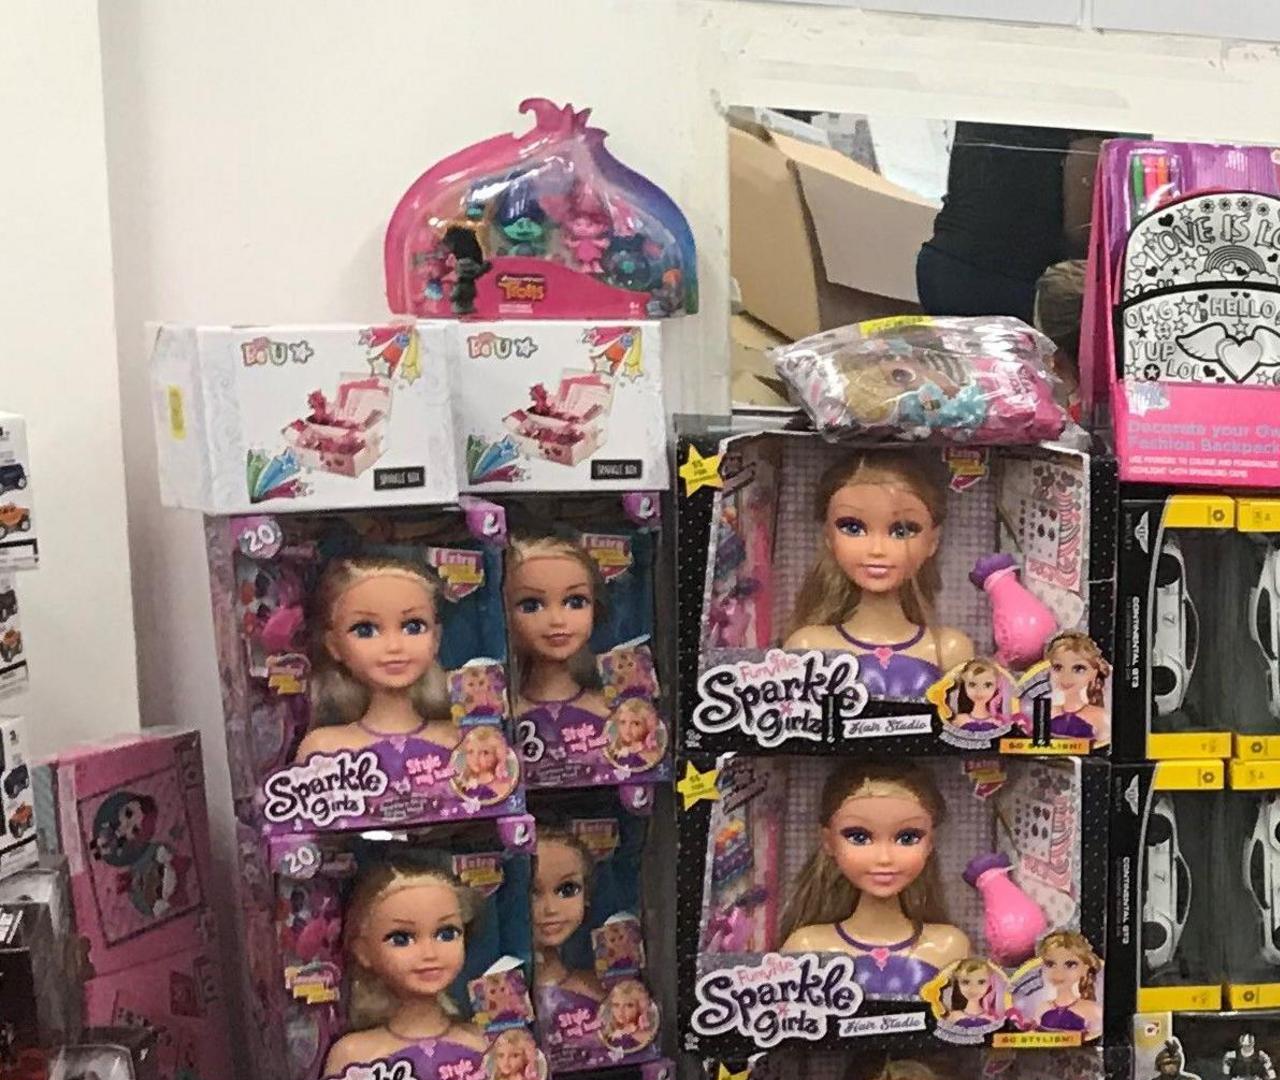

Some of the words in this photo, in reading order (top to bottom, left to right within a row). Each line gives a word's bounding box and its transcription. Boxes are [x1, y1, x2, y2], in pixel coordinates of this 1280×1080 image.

[1220, 214, 1252, 241] IS
[1211, 297, 1277, 318] HELLO
[244, 526, 276, 554] 20
[700, 655, 861, 734] Sparkle
[267, 753, 385, 820] Sparkle
[284, 849, 317, 873] 20
[699, 958, 857, 1037] Sparkle
